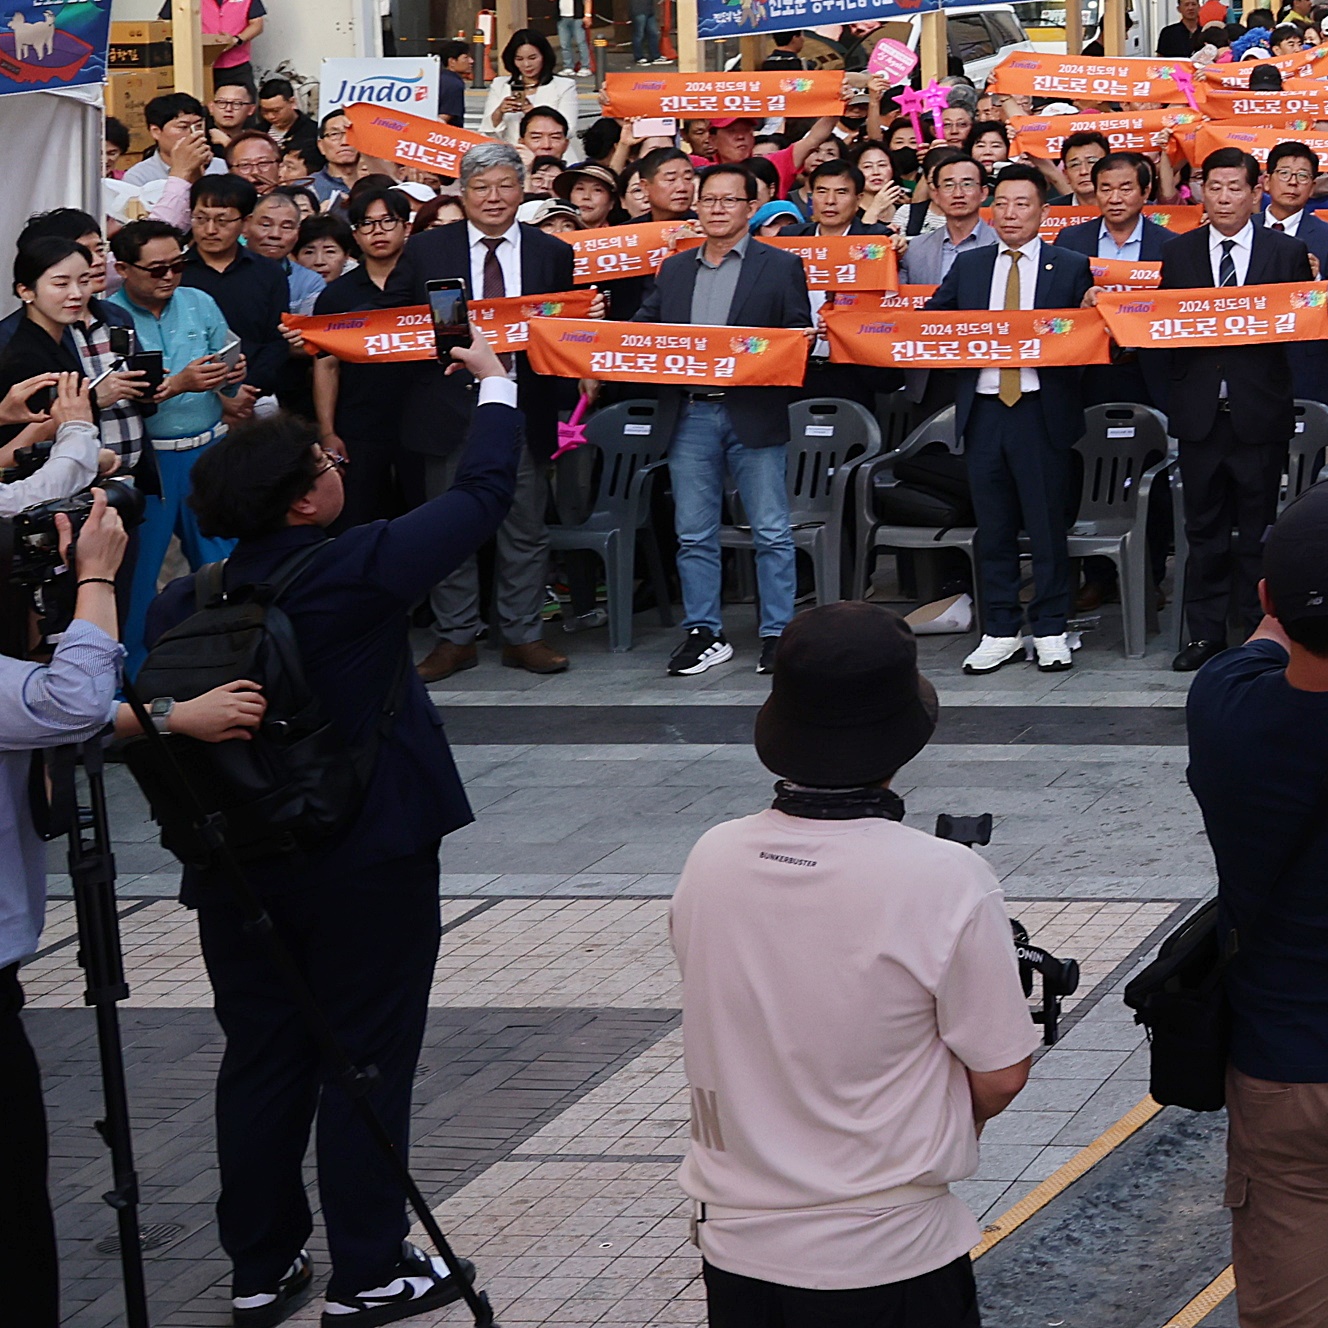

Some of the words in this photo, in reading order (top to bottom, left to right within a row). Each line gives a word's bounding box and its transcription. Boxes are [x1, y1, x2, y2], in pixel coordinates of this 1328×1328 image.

[329, 80, 412, 104] Jindo
[686, 82, 712, 91] 2024
[715, 81, 748, 92] 진도의
[751, 81, 760, 92] 날
[660, 96, 719, 112] 진도로
[724, 95, 762, 112] 오는
[767, 95, 786, 111] 길
[427, 132, 456, 148] 2024
[395, 139, 457, 171] 진도로
[1179, 301, 1209, 312] 2024
[1213, 298, 1250, 310] 진도의
[1254, 296, 1266, 309] 날
[921, 324, 951, 336] 2024
[956, 323, 996, 336] 진도의
[999, 321, 1009, 335] 날
[1149, 319, 1217, 340] 진도로
[1224, 316, 1269, 337] 오는
[1274, 313, 1296, 334] 길
[621, 334, 652, 347] 2024
[654, 334, 694, 350] 진도의
[698, 336, 707, 350] 날
[891, 338, 961, 362] 진도로
[968, 340, 1012, 360] 오는
[1019, 339, 1041, 360] 길
[590, 352, 657, 372] 진도로
[663, 354, 707, 375] 오는
[715, 356, 735, 377] 길
[759, 851, 818, 868] BUNKERBUSTER
